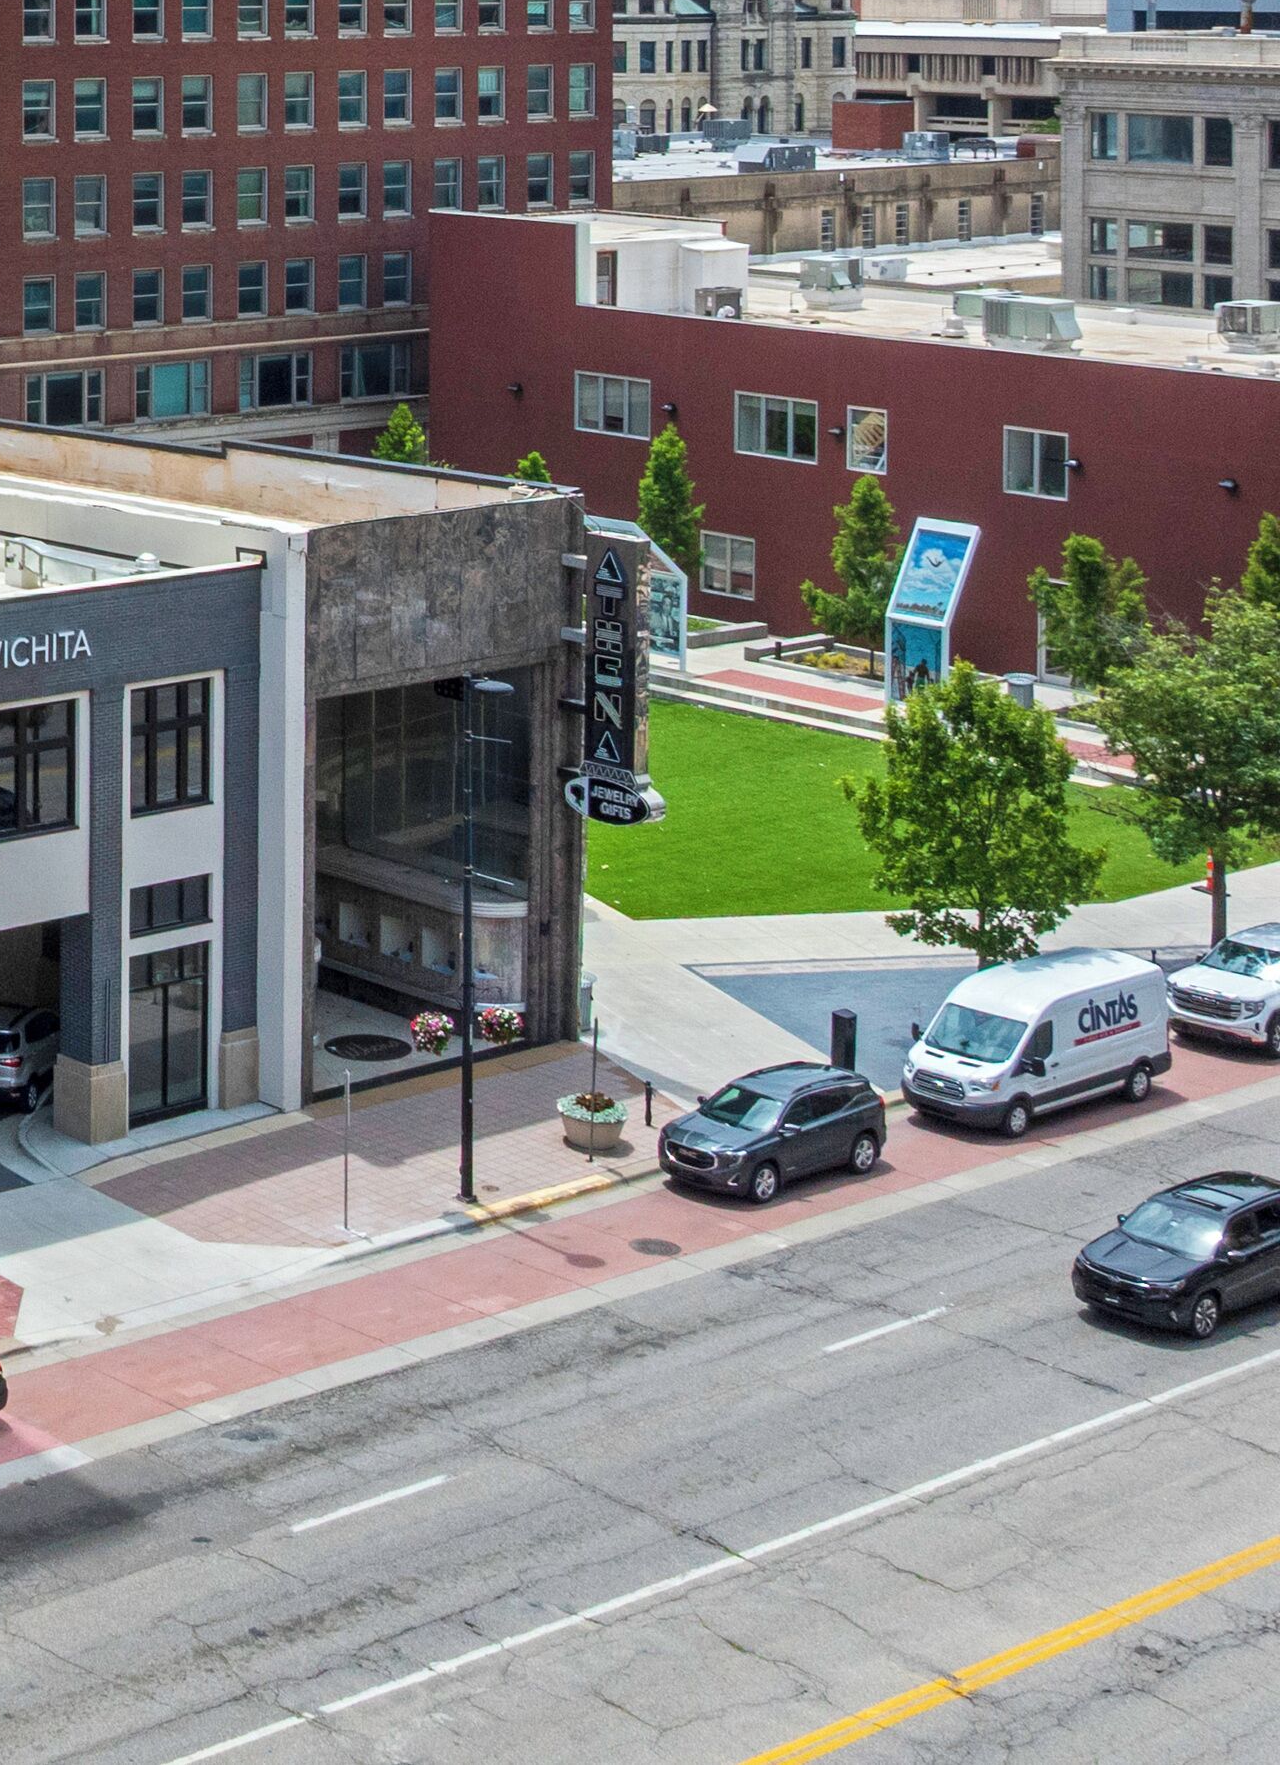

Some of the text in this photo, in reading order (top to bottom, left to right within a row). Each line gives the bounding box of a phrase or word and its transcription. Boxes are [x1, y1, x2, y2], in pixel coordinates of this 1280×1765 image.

[593, 548, 624, 764] ATHENA
[591, 785, 639, 808] JEWELRY
[600, 802, 632, 820] GIFTS
